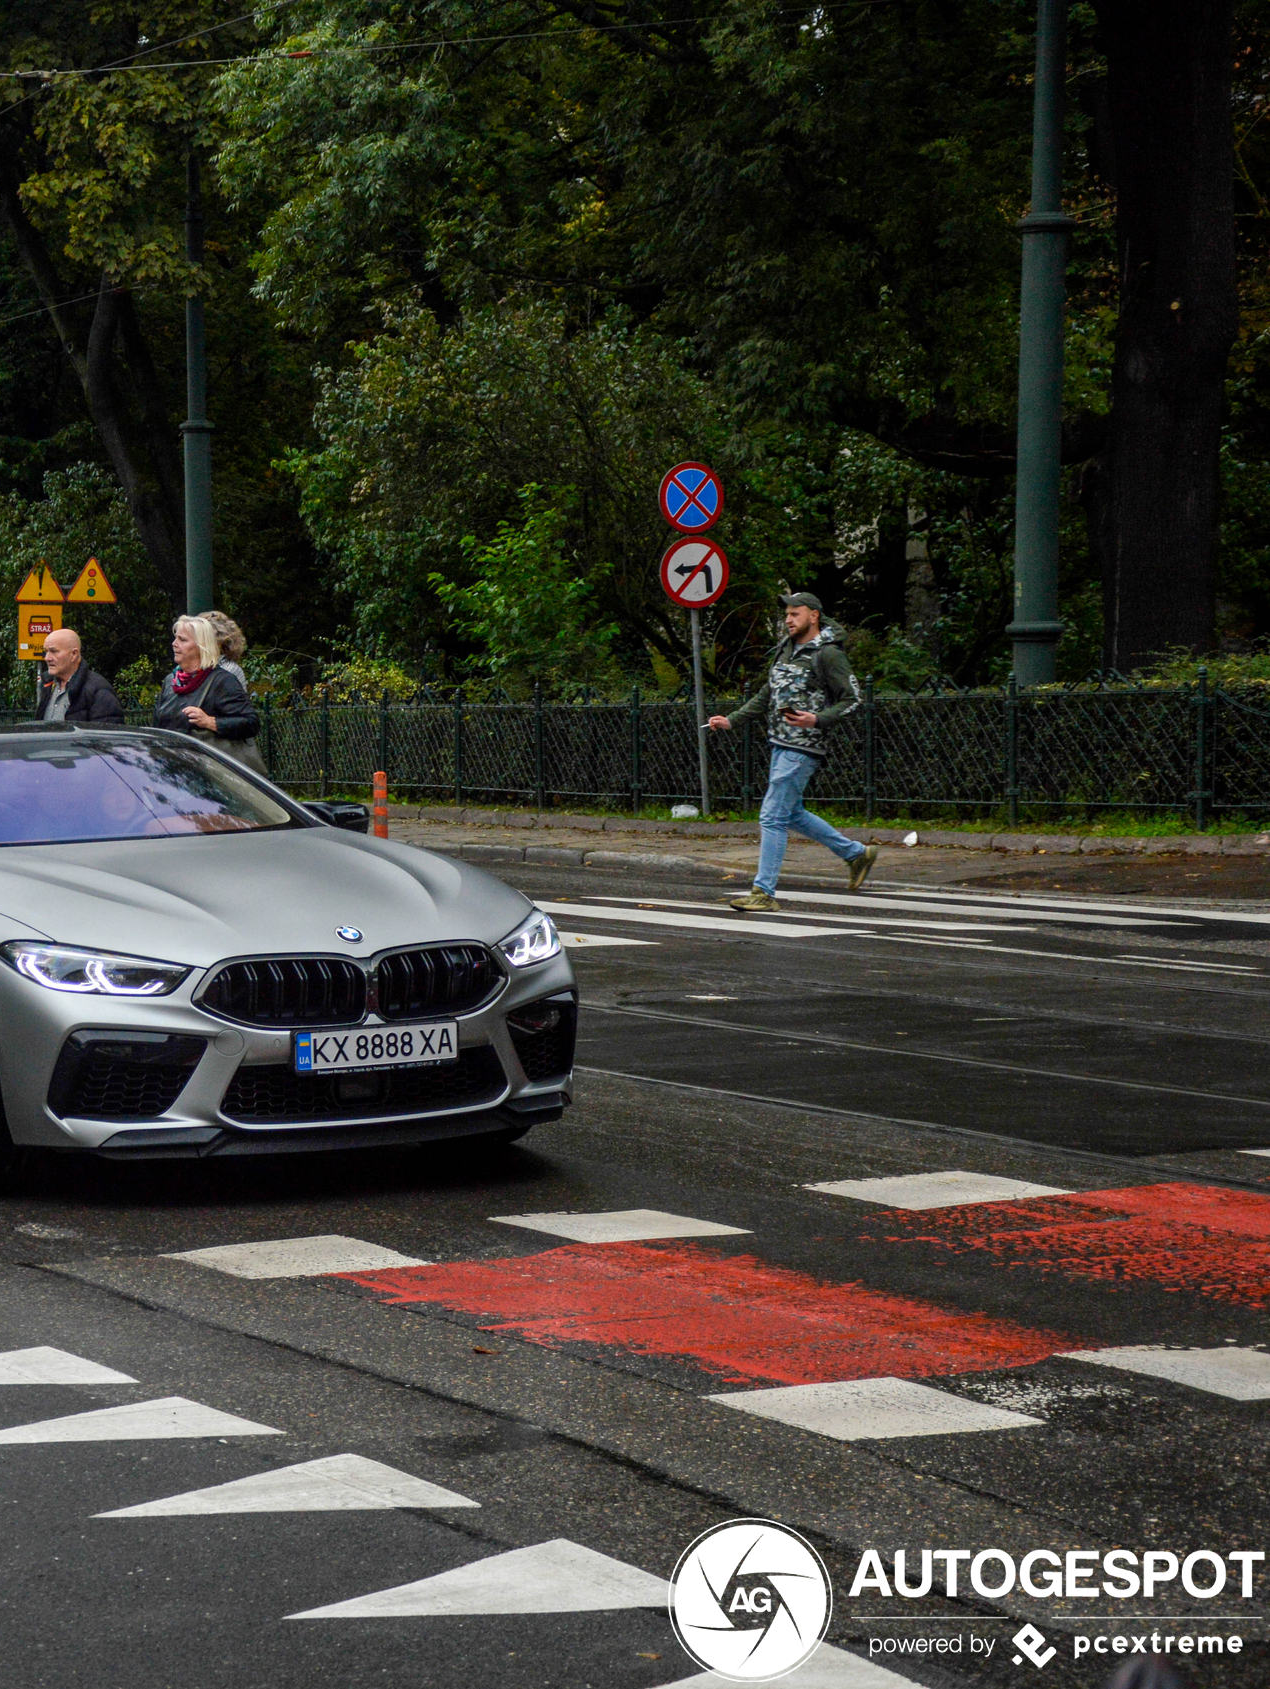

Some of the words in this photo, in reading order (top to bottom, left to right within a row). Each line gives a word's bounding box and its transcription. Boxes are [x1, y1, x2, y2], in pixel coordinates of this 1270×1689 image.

[31, 624, 51, 632] STRAŻ
[313, 1036, 349, 1064] KX
[356, 1031, 413, 1060] 8888
[419, 1028, 453, 1056] XA
[299, 1057, 310, 1065] UA
